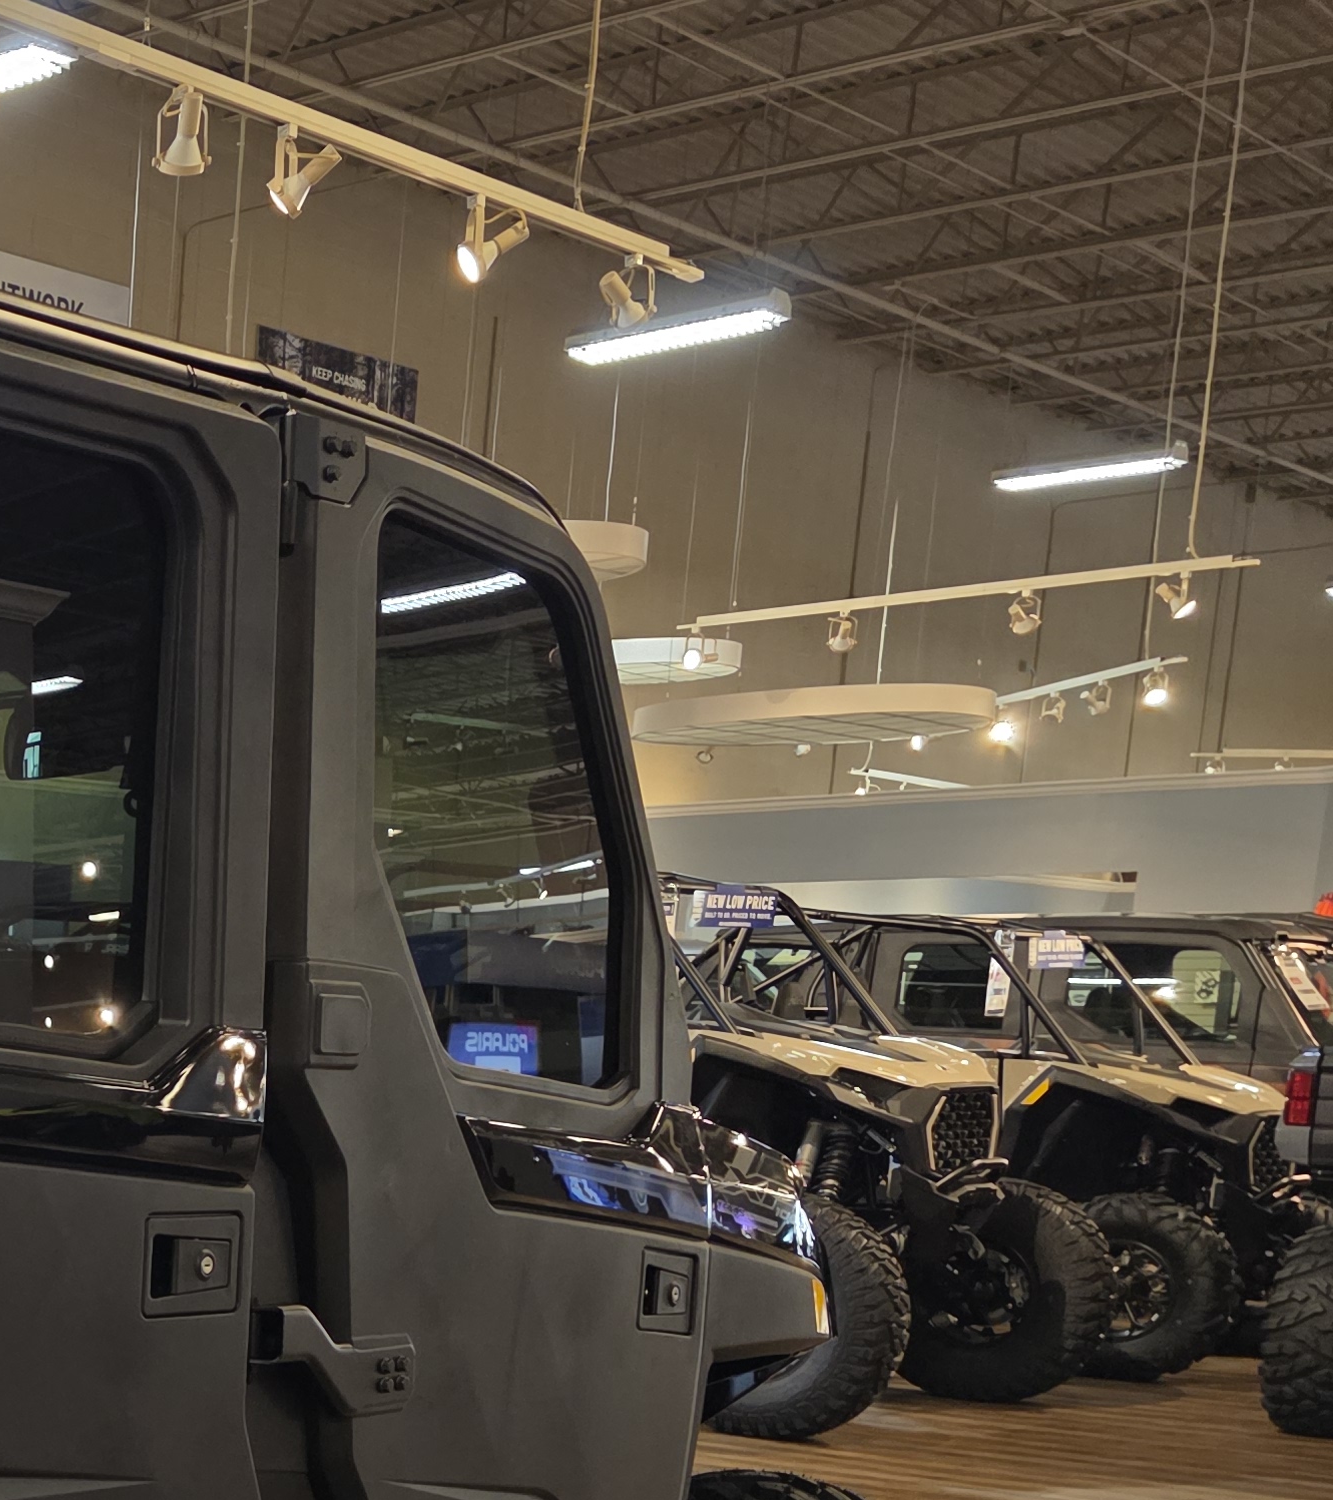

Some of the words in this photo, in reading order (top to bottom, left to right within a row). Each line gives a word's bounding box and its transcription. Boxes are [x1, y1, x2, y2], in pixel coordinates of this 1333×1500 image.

[312, 366, 332, 381] KEEP
[333, 372, 367, 391] CHASING
[706, 894, 726, 908] NEW
[726, 895, 745, 909] LOW
[746, 896, 775, 910] PRICE
